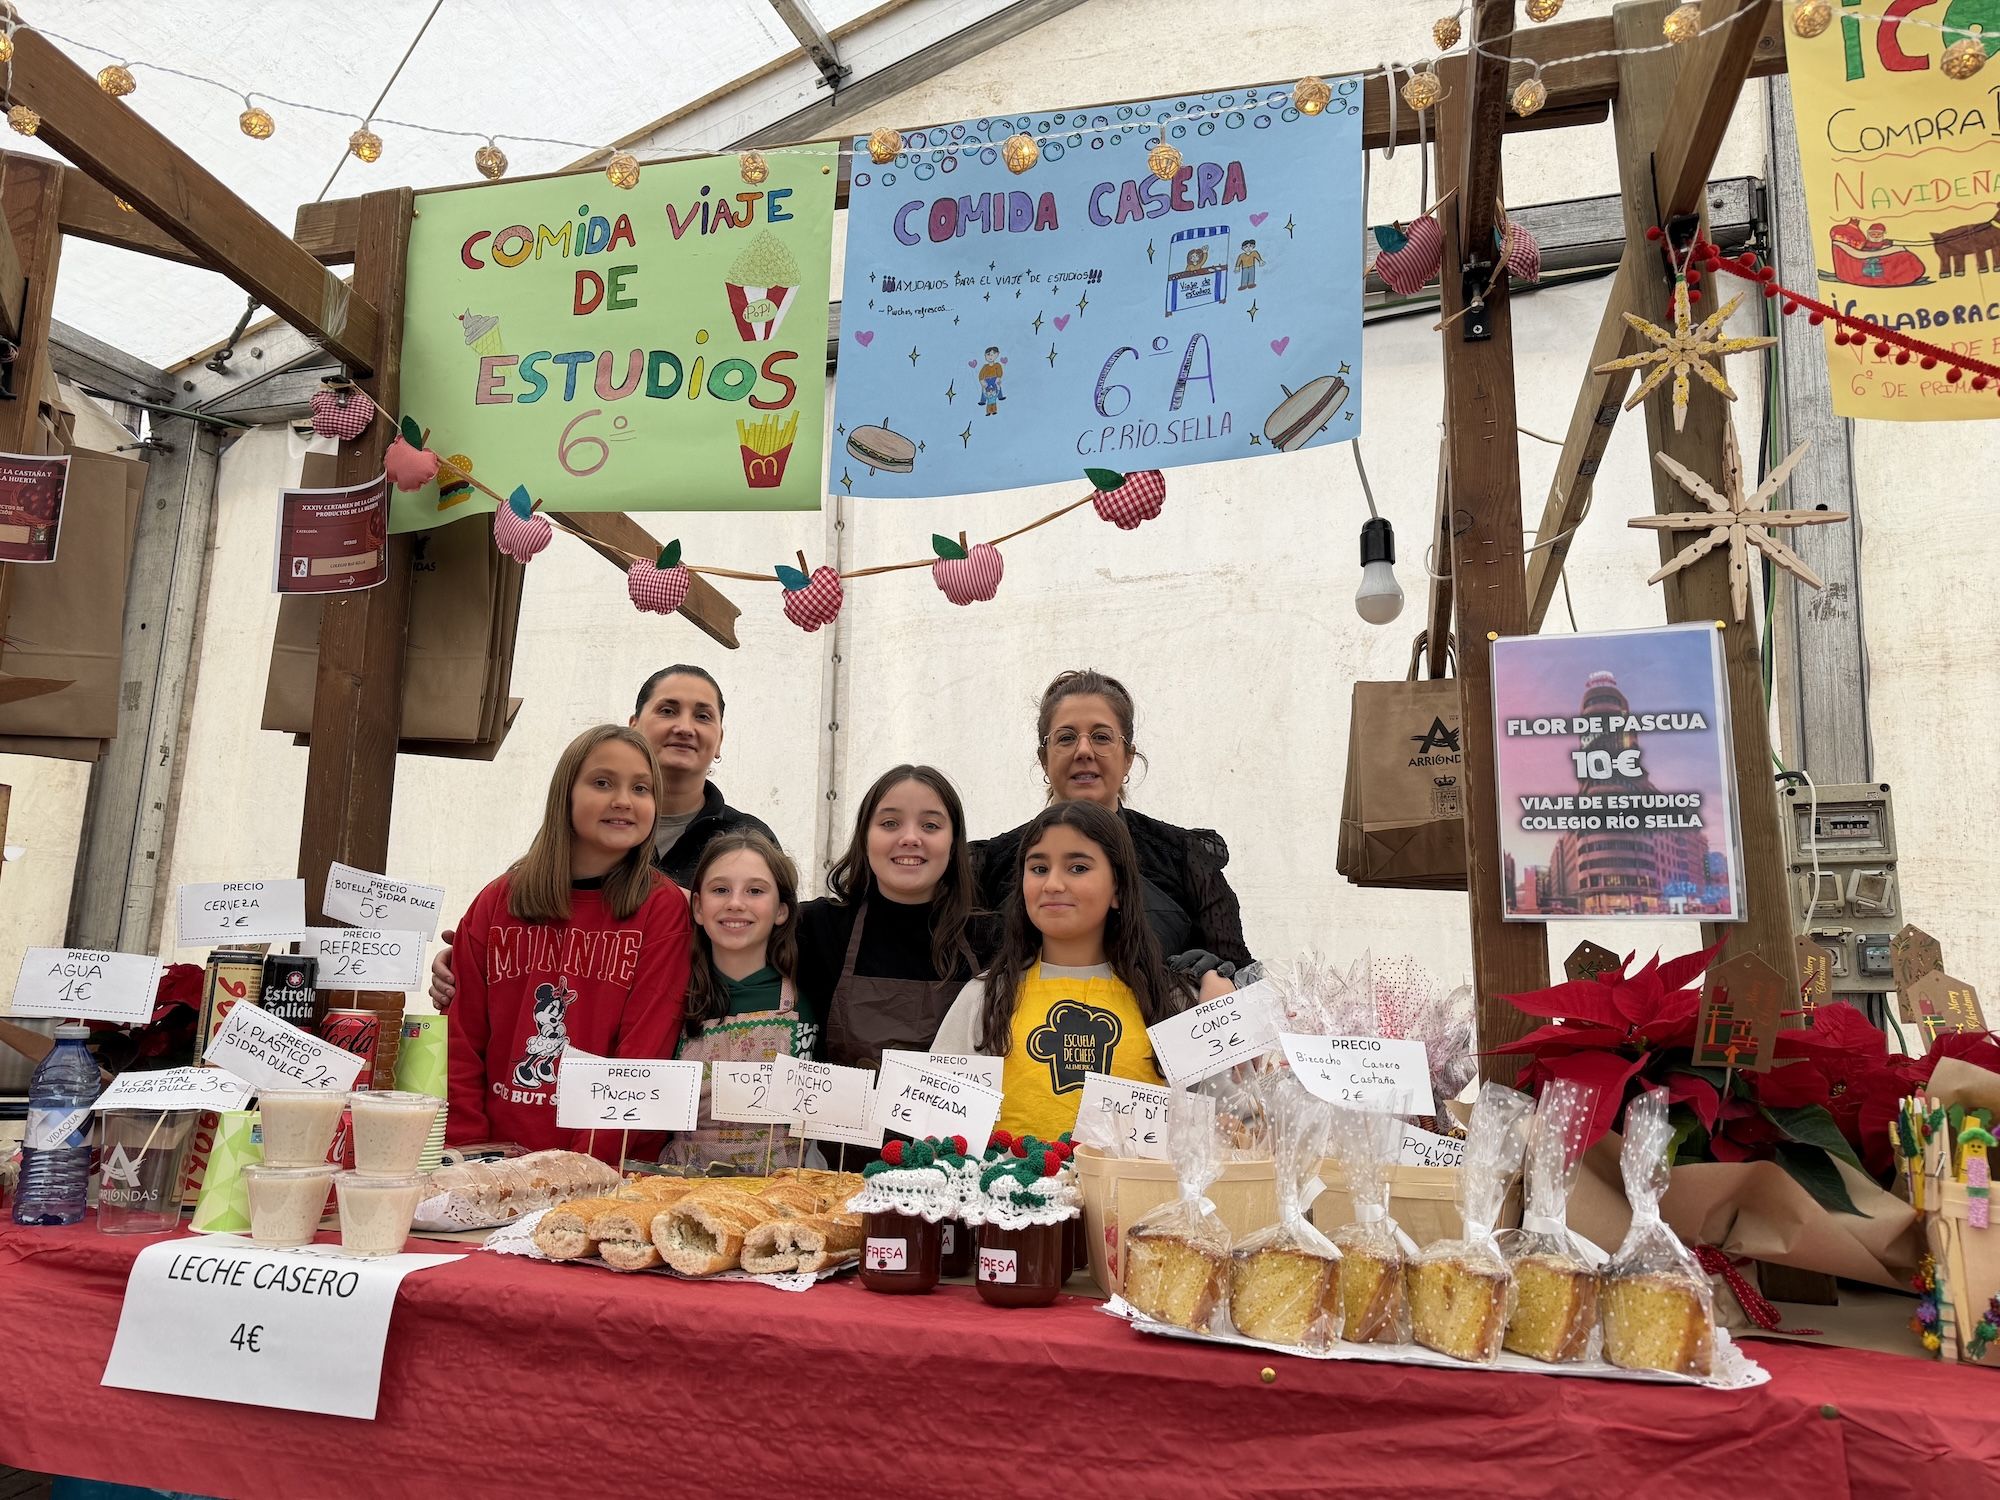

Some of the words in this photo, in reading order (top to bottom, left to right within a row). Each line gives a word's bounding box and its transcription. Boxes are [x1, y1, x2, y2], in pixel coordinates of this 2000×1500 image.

[1827, 108, 1985, 153] COMPRA
[893, 191, 1059, 246] COMIDA
[1088, 160, 1248, 226] CASERA
[954, 274, 975, 287] PARA
[980, 275, 991, 286] EL
[1030, 273, 1041, 284] DE
[573, 265, 638, 315] DE
[1852, 370, 1873, 396] 6º
[1881, 381, 1908, 398] DE
[558, 409, 637, 477] 6º
[9, 476, 37, 484] HUERTA
[316, 509, 350, 518] PRODUCTOS
[323, 502, 353, 511] CERTAMEN
[1507, 718, 1568, 736] FLOR
[1572, 716, 1603, 734] DE
[1609, 713, 1707, 733] PASCUA
[1572, 749, 1643, 779] 10€
[1520, 797, 1574, 811] VIAJE
[1579, 796, 1603, 810] DE
[1607, 794, 1701, 809] ESTUDIOS
[1521, 816, 1601, 830] COLEGIO
[1606, 811, 1639, 829] RÍO
[1645, 814, 1703, 828] SELLA
[223, 882, 264, 892] PRECIO
[335, 879, 373, 896] BOTELLA
[377, 890, 407, 904] SIDRA
[410, 897, 436, 911] DULCE
[369, 880, 408, 895] PRECIO
[204, 898, 260, 912] CERVEZA
[359, 897, 388, 919] 5€
[343, 930, 381, 940] PRECIO
[68, 952, 110, 963] PRECIO
[320, 940, 401, 957] REFRESCO
[487, 925, 643, 990] MINNIE
[48, 964, 102, 979] AGUA
[334, 955, 367, 977] 2€
[58, 979, 93, 1001] 1€
[263, 985, 316, 1003] Estrella
[263, 1001, 313, 1019] Galicia
[1195, 996, 1235, 1017] PRECIO
[1948, 990, 1962, 1014] Merry
[1967, 989, 1980, 1031] Christmas
[1190, 1010, 1242, 1040] CONOS
[251, 1026, 310, 1065] PLÁSTICO
[280, 1032, 322, 1057] PRECIO
[1064, 1034, 1096, 1048] ESCUELA
[1331, 1039, 1381, 1051] PRECIO
[225, 1033, 265, 1062] SIDRA
[267, 1054, 304, 1080] DULCE
[930, 1055, 968, 1066] PRECIO
[1064, 1049, 1073, 1062] DE
[1074, 1049, 1096, 1064] CHEFS
[1362, 1058, 1400, 1070] Casero
[166, 1067, 210, 1076] PRECIO
[302, 1064, 338, 1089] 2€
[608, 1069, 651, 1078] PRECIO
[798, 1062, 831, 1075] PRECIO
[1320, 1068, 1332, 1081] de
[1350, 1072, 1396, 1085] Castaña
[113, 1085, 154, 1094] SIDRA
[157, 1083, 197, 1092] DULCE
[200, 1076, 238, 1093] 3€
[920, 1074, 960, 1095] PRECIO
[511, 1090, 546, 1105] BUT
[792, 1088, 818, 1115] 2€
[900, 1085, 967, 1118] MERMELADA
[892, 1103, 912, 1122] 8€
[46, 1113, 81, 1143] VIDAQUA
[866, 1245, 903, 1259] FRESA
[980, 1256, 1016, 1272] FRESA
[168, 1254, 251, 1287] LECHE
[253, 1263, 359, 1299] CASERO
[230, 1323, 264, 1353] 4€
